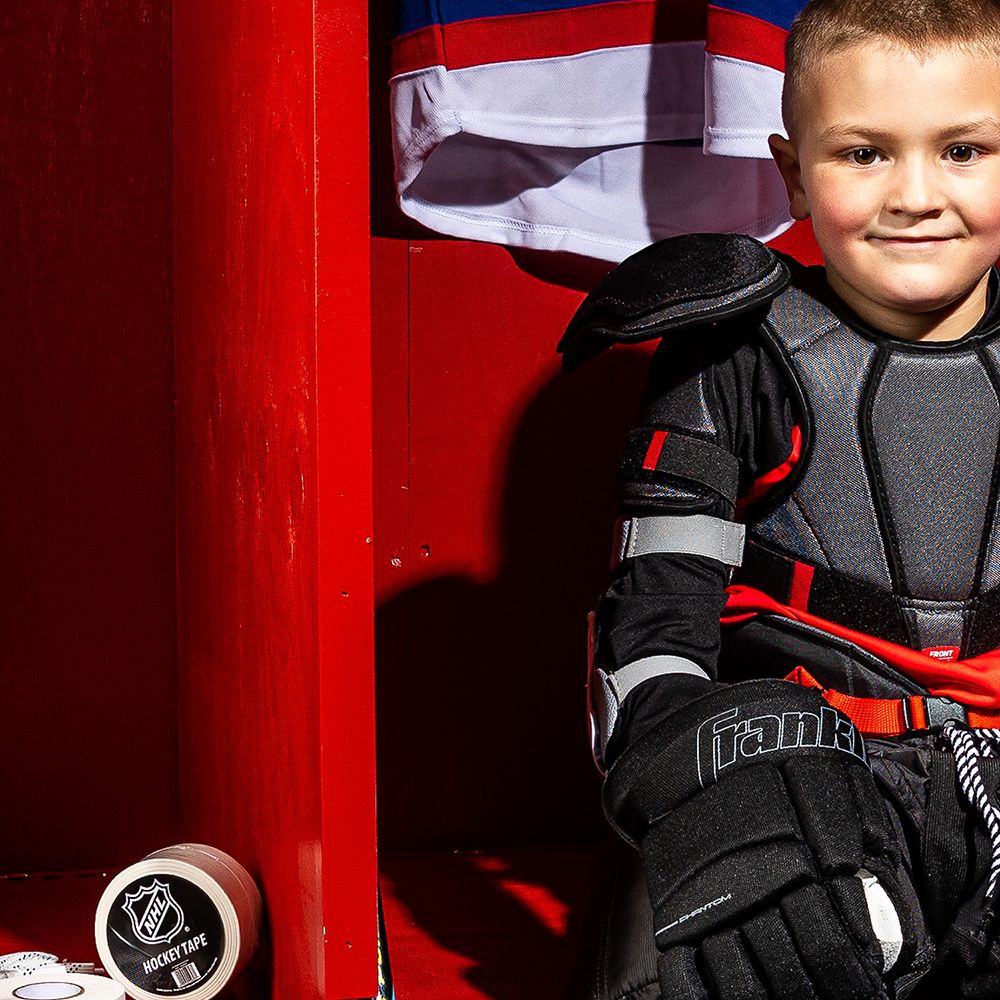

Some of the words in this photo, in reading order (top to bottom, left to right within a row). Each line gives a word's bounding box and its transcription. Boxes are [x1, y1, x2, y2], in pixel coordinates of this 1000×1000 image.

[929, 649, 954, 658] FRONT
[144, 896, 166, 936] NHL
[678, 892, 732, 924] PHANTOM
[142, 945, 182, 975] HOCKEY
[183, 932, 208, 956] TAPE
